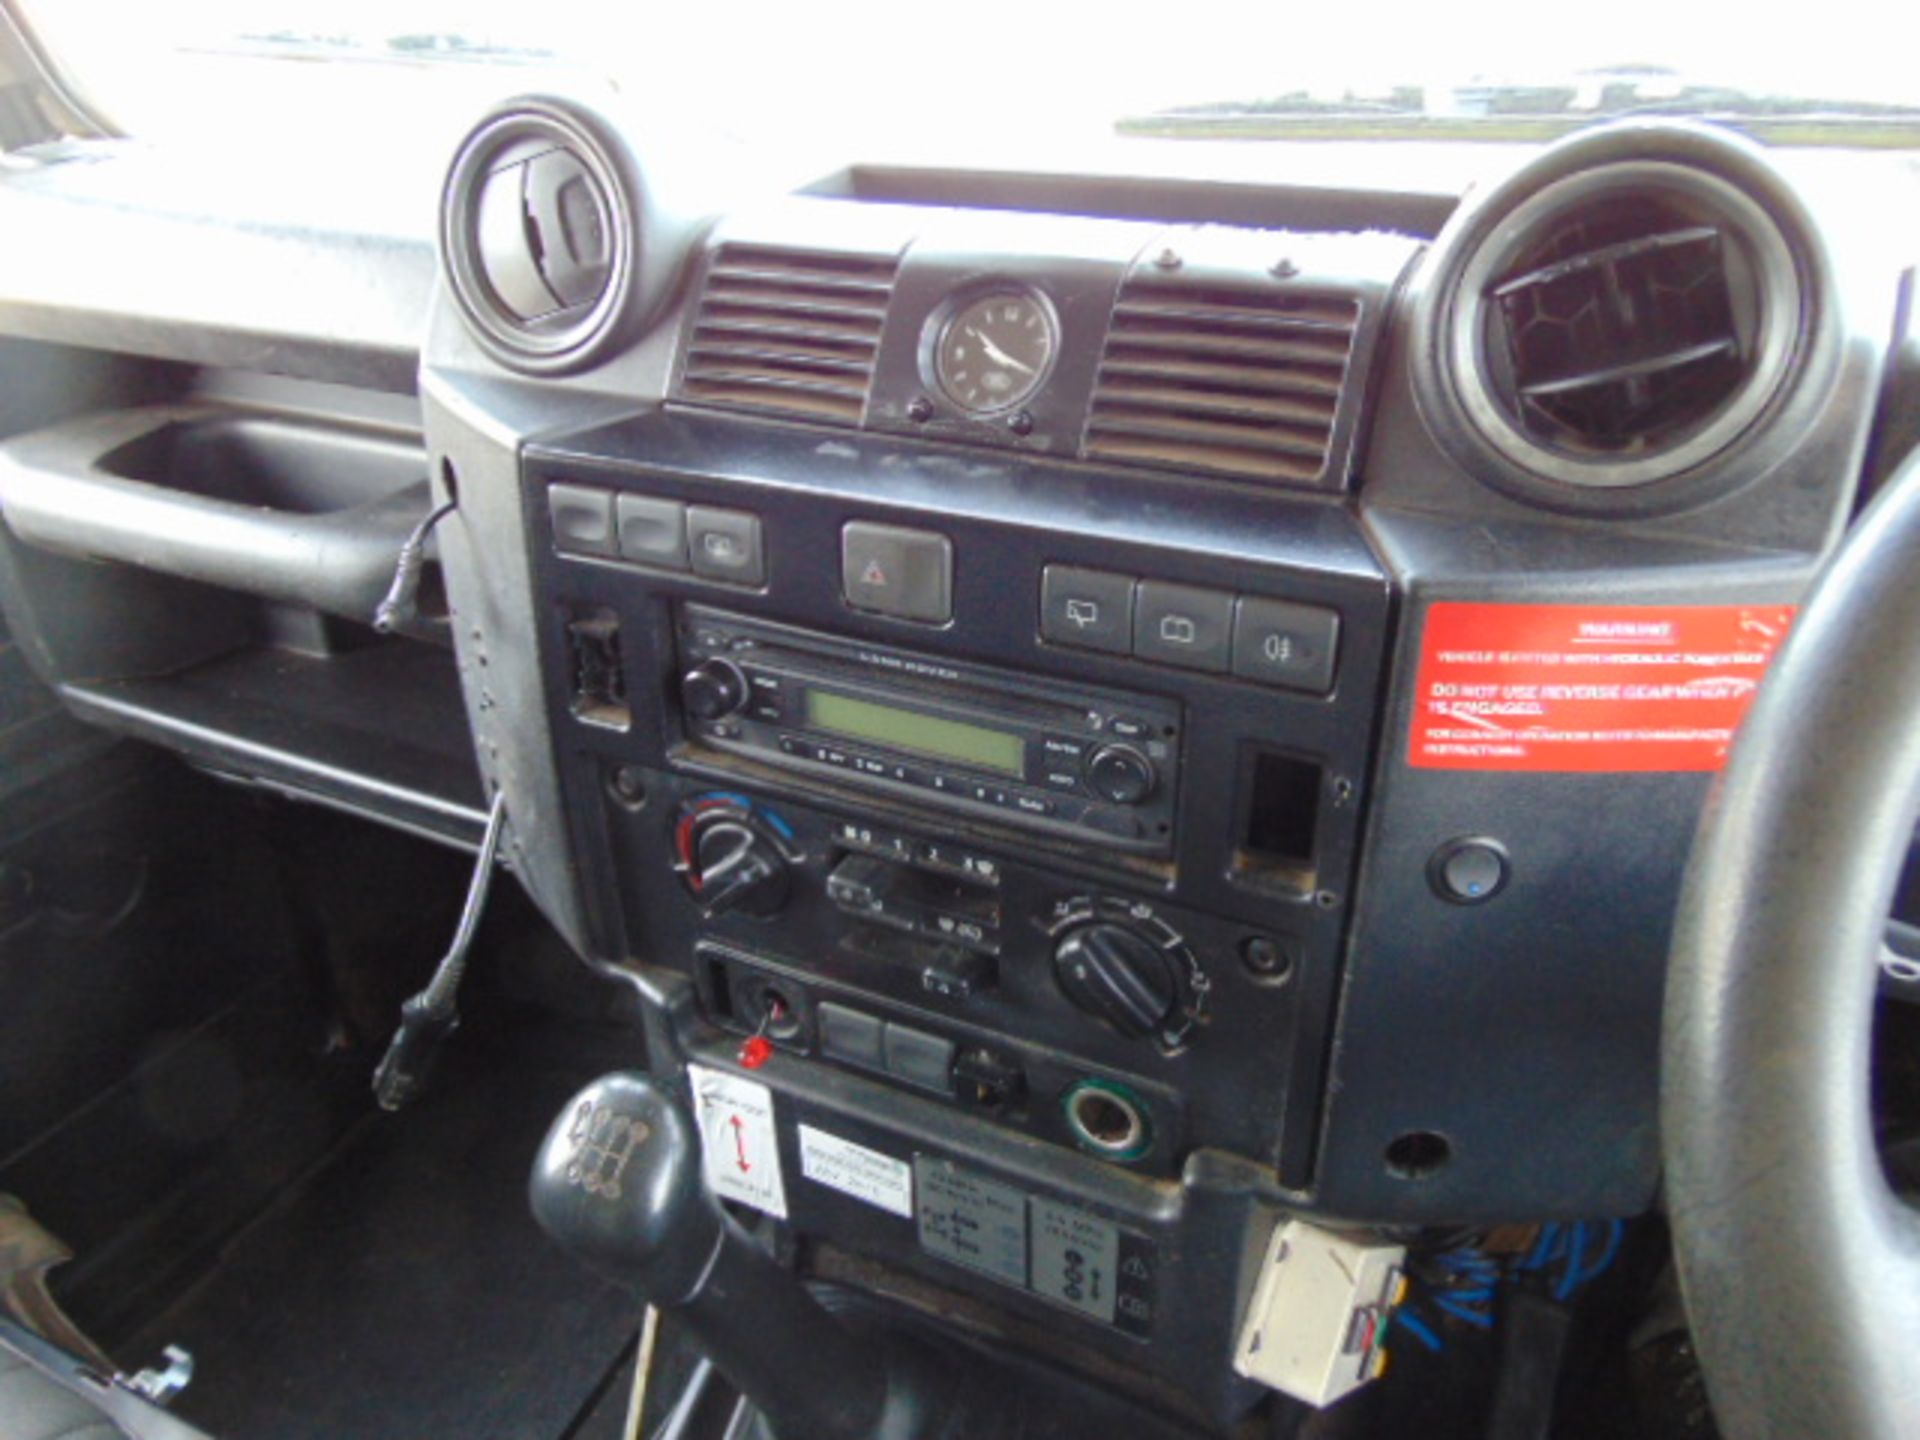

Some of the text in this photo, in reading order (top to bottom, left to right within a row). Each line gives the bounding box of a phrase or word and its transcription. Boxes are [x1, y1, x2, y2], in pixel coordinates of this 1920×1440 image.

[1432, 683, 1457, 698] DO
[1459, 684, 1499, 699] NOT
[1503, 685, 1538, 700] USE
[1541, 685, 1620, 700] REVERSE
[1621, 685, 1675, 700] GEAR
